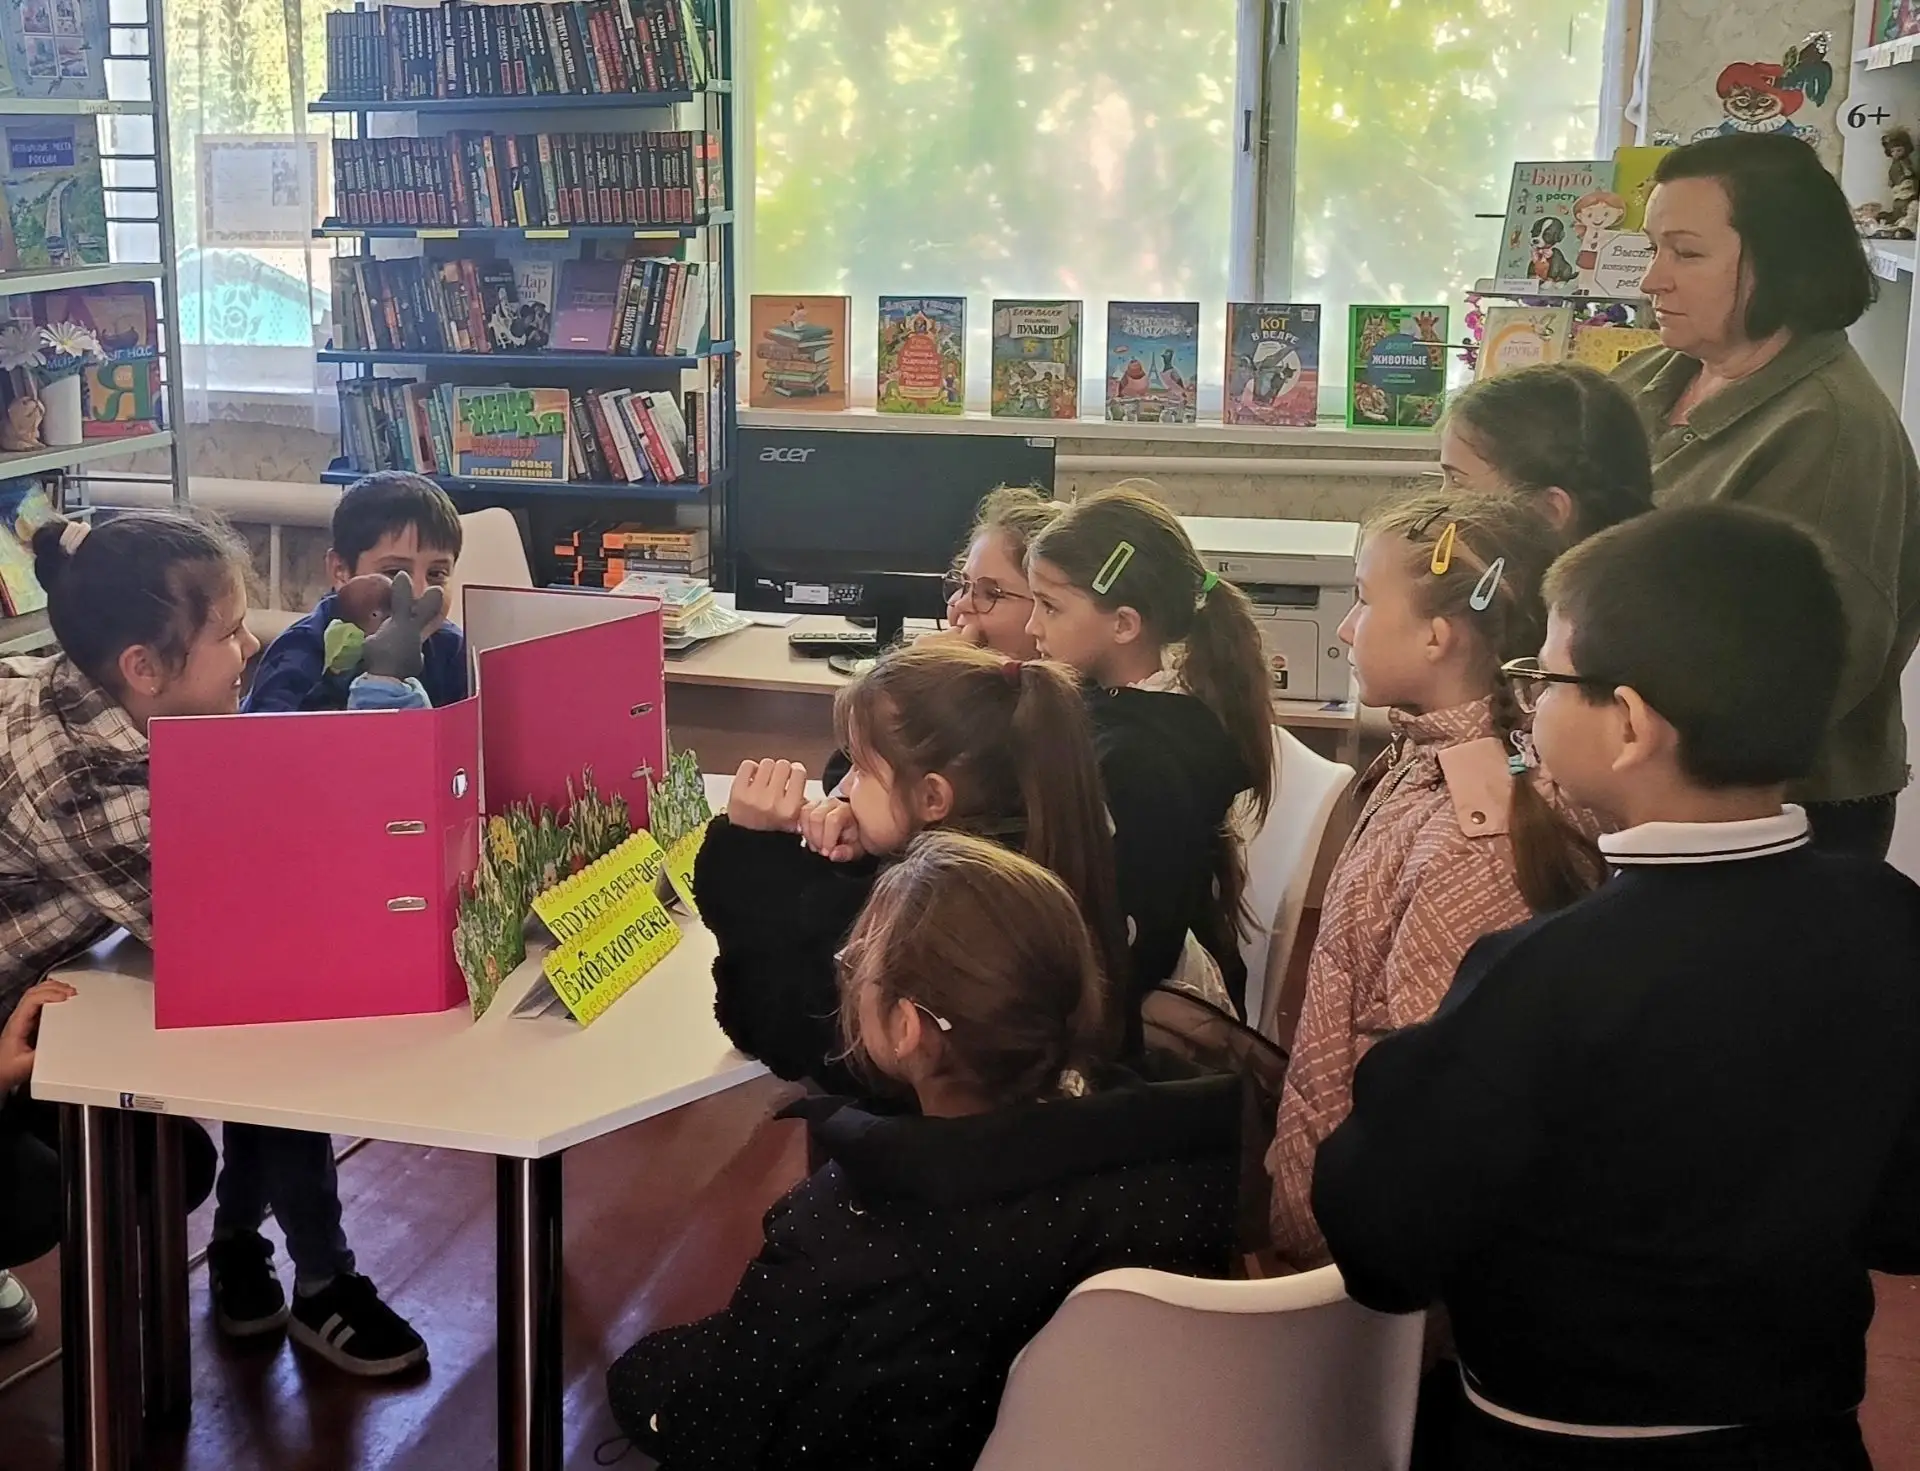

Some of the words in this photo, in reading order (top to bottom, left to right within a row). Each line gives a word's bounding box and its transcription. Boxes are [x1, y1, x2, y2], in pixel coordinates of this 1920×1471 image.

[1847, 103, 1891, 128] 6+
[1532, 168, 1593, 191] Барто
[1260, 316, 1290, 330] КОТ
[1262, 330, 1300, 345] ВЕДРЕ
[1372, 354, 1428, 366] ЖИВОТНЫЕ
[760, 447, 816, 462] acer
[511, 460, 553, 468] НОВЫХ
[471, 467, 553, 478] ПОСТУПЛЕНИЙ
[550, 849, 664, 941] приглашает
[552, 905, 671, 1006] Библиотека
